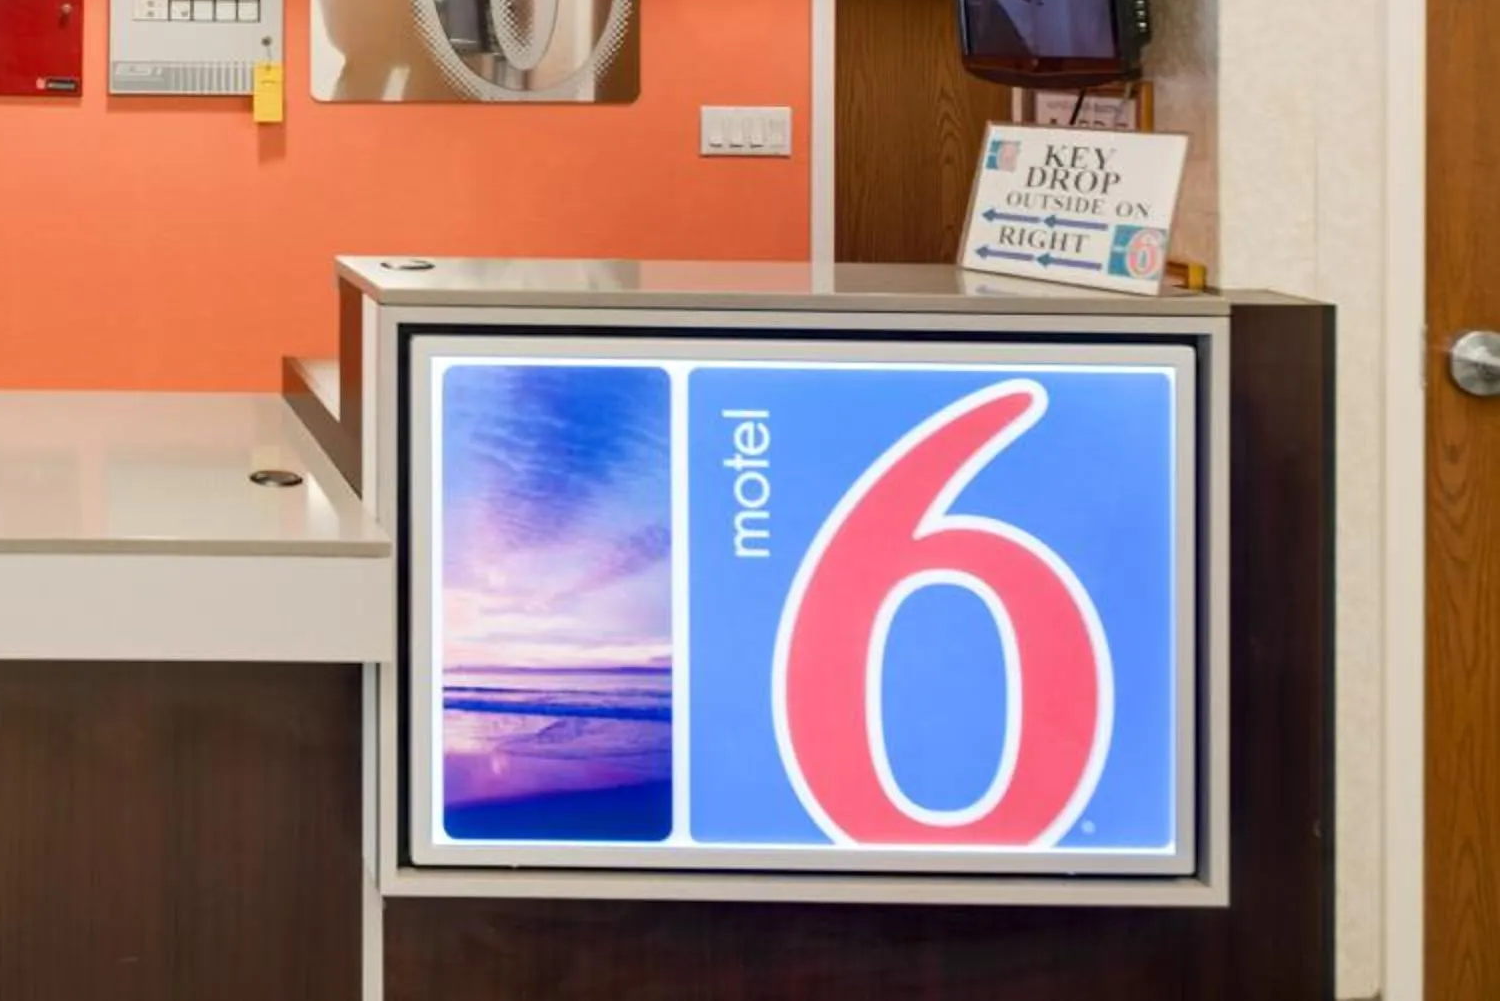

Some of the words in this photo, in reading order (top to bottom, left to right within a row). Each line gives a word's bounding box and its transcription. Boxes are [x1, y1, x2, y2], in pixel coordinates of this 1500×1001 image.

[1044, 144, 1117, 171] KEY
[1025, 166, 1122, 195] DROP
[1005, 190, 1106, 216] OUTSIDE
[1115, 201, 1152, 218] ON
[998, 226, 1092, 254] RIGHT
[722, 408, 770, 558] motel
[771, 378, 1116, 847] 6
